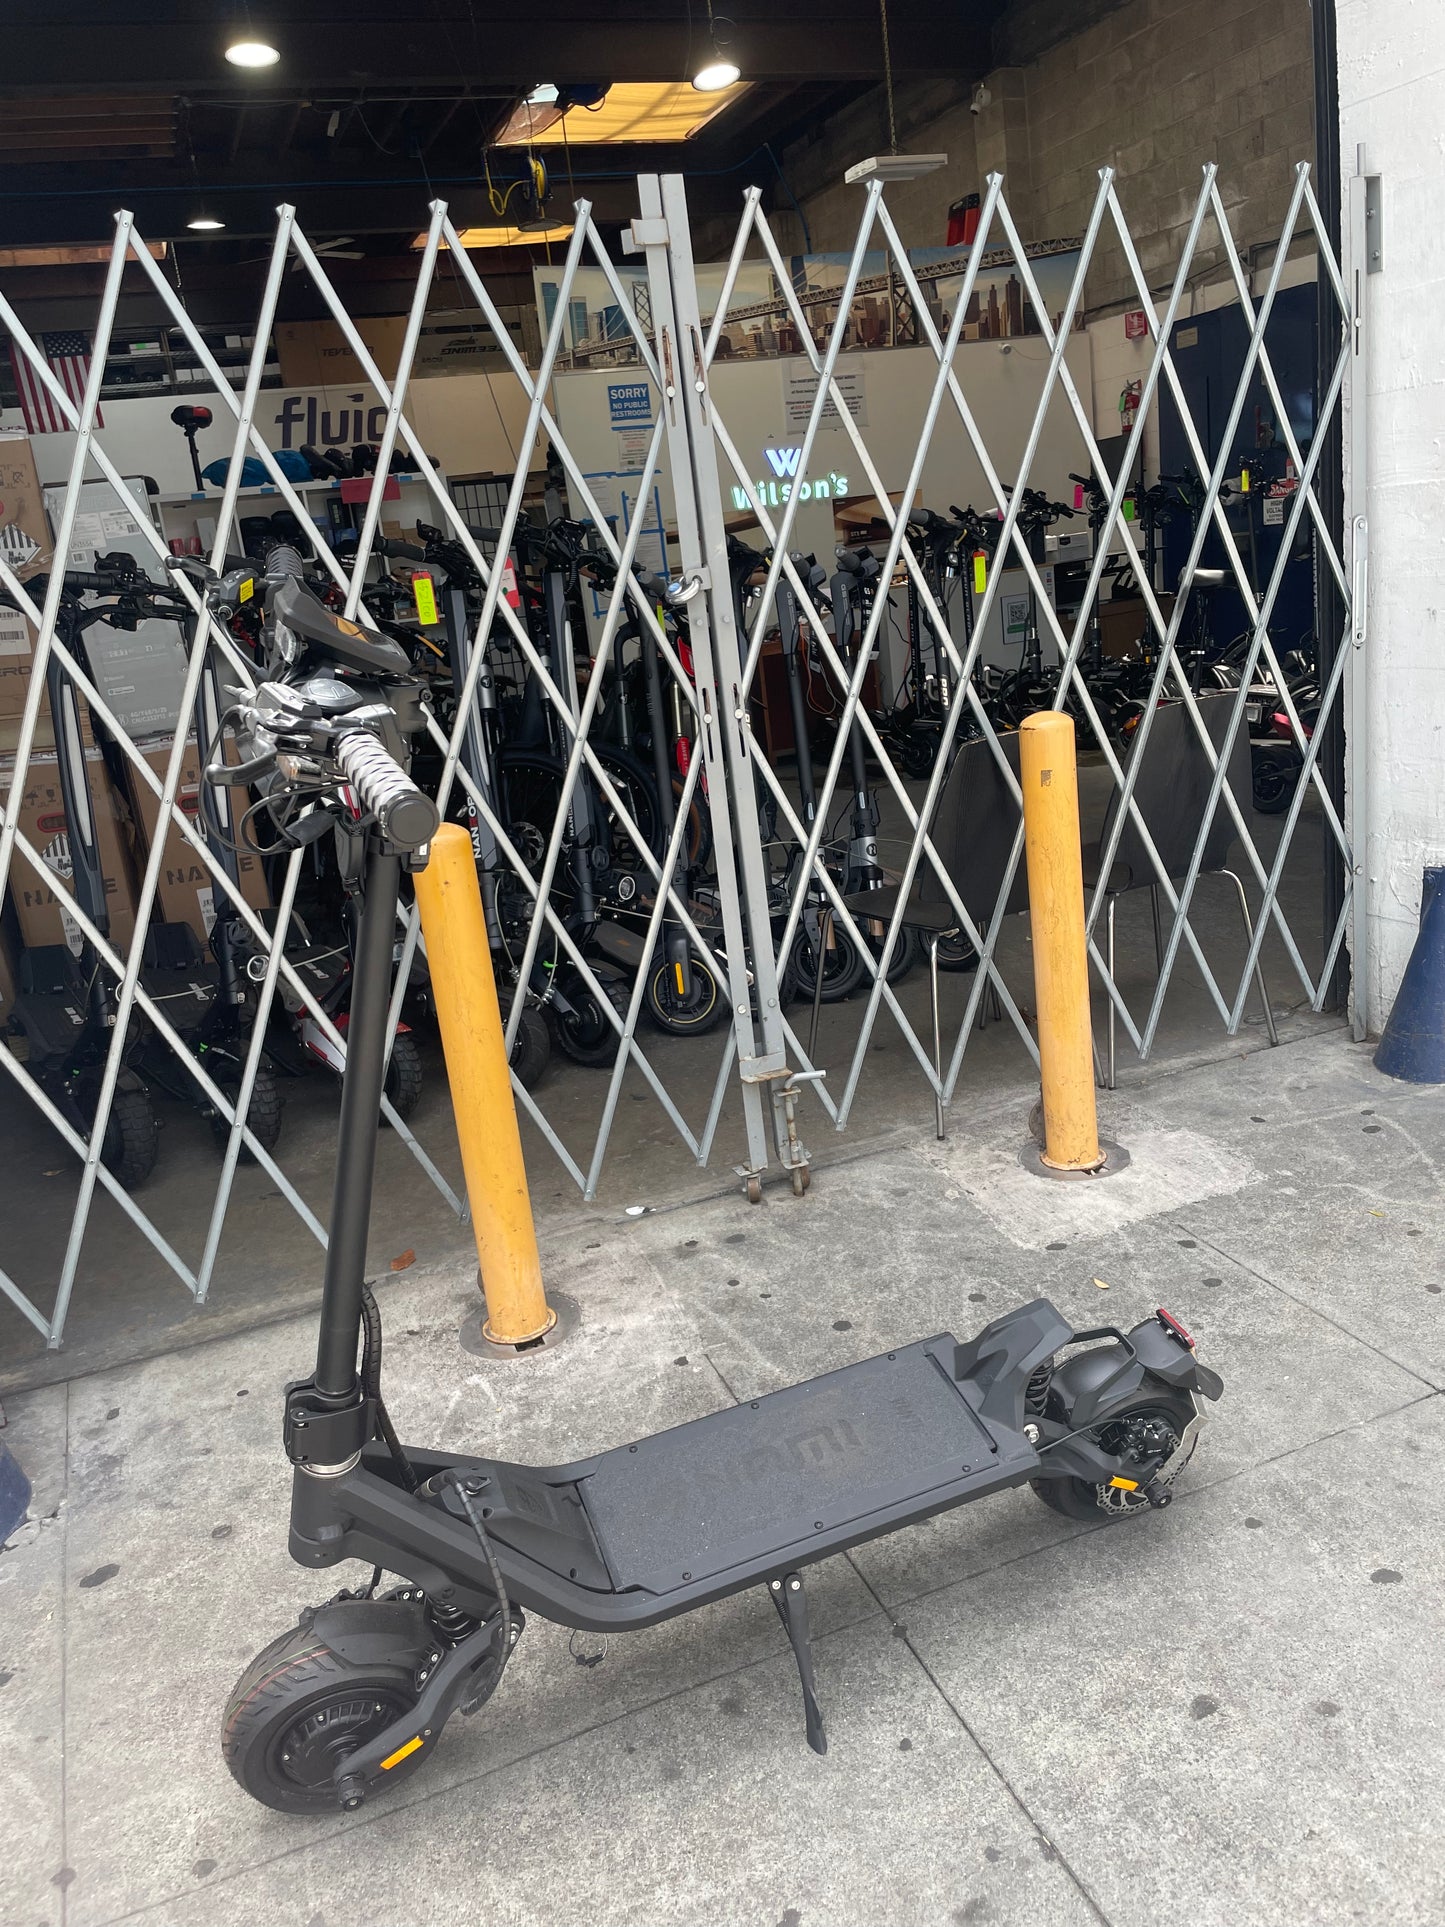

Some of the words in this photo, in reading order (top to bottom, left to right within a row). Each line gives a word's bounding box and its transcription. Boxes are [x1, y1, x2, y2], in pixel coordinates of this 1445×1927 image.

[610, 387, 647, 399] SORRY
[624, 401, 648, 409] PUBLIC
[611, 409, 652, 418] RESTROOMS
[731, 472, 849, 509] Wilson's
[1270, 483, 1300, 495] DANGR
[166, 856, 254, 885] NAE
